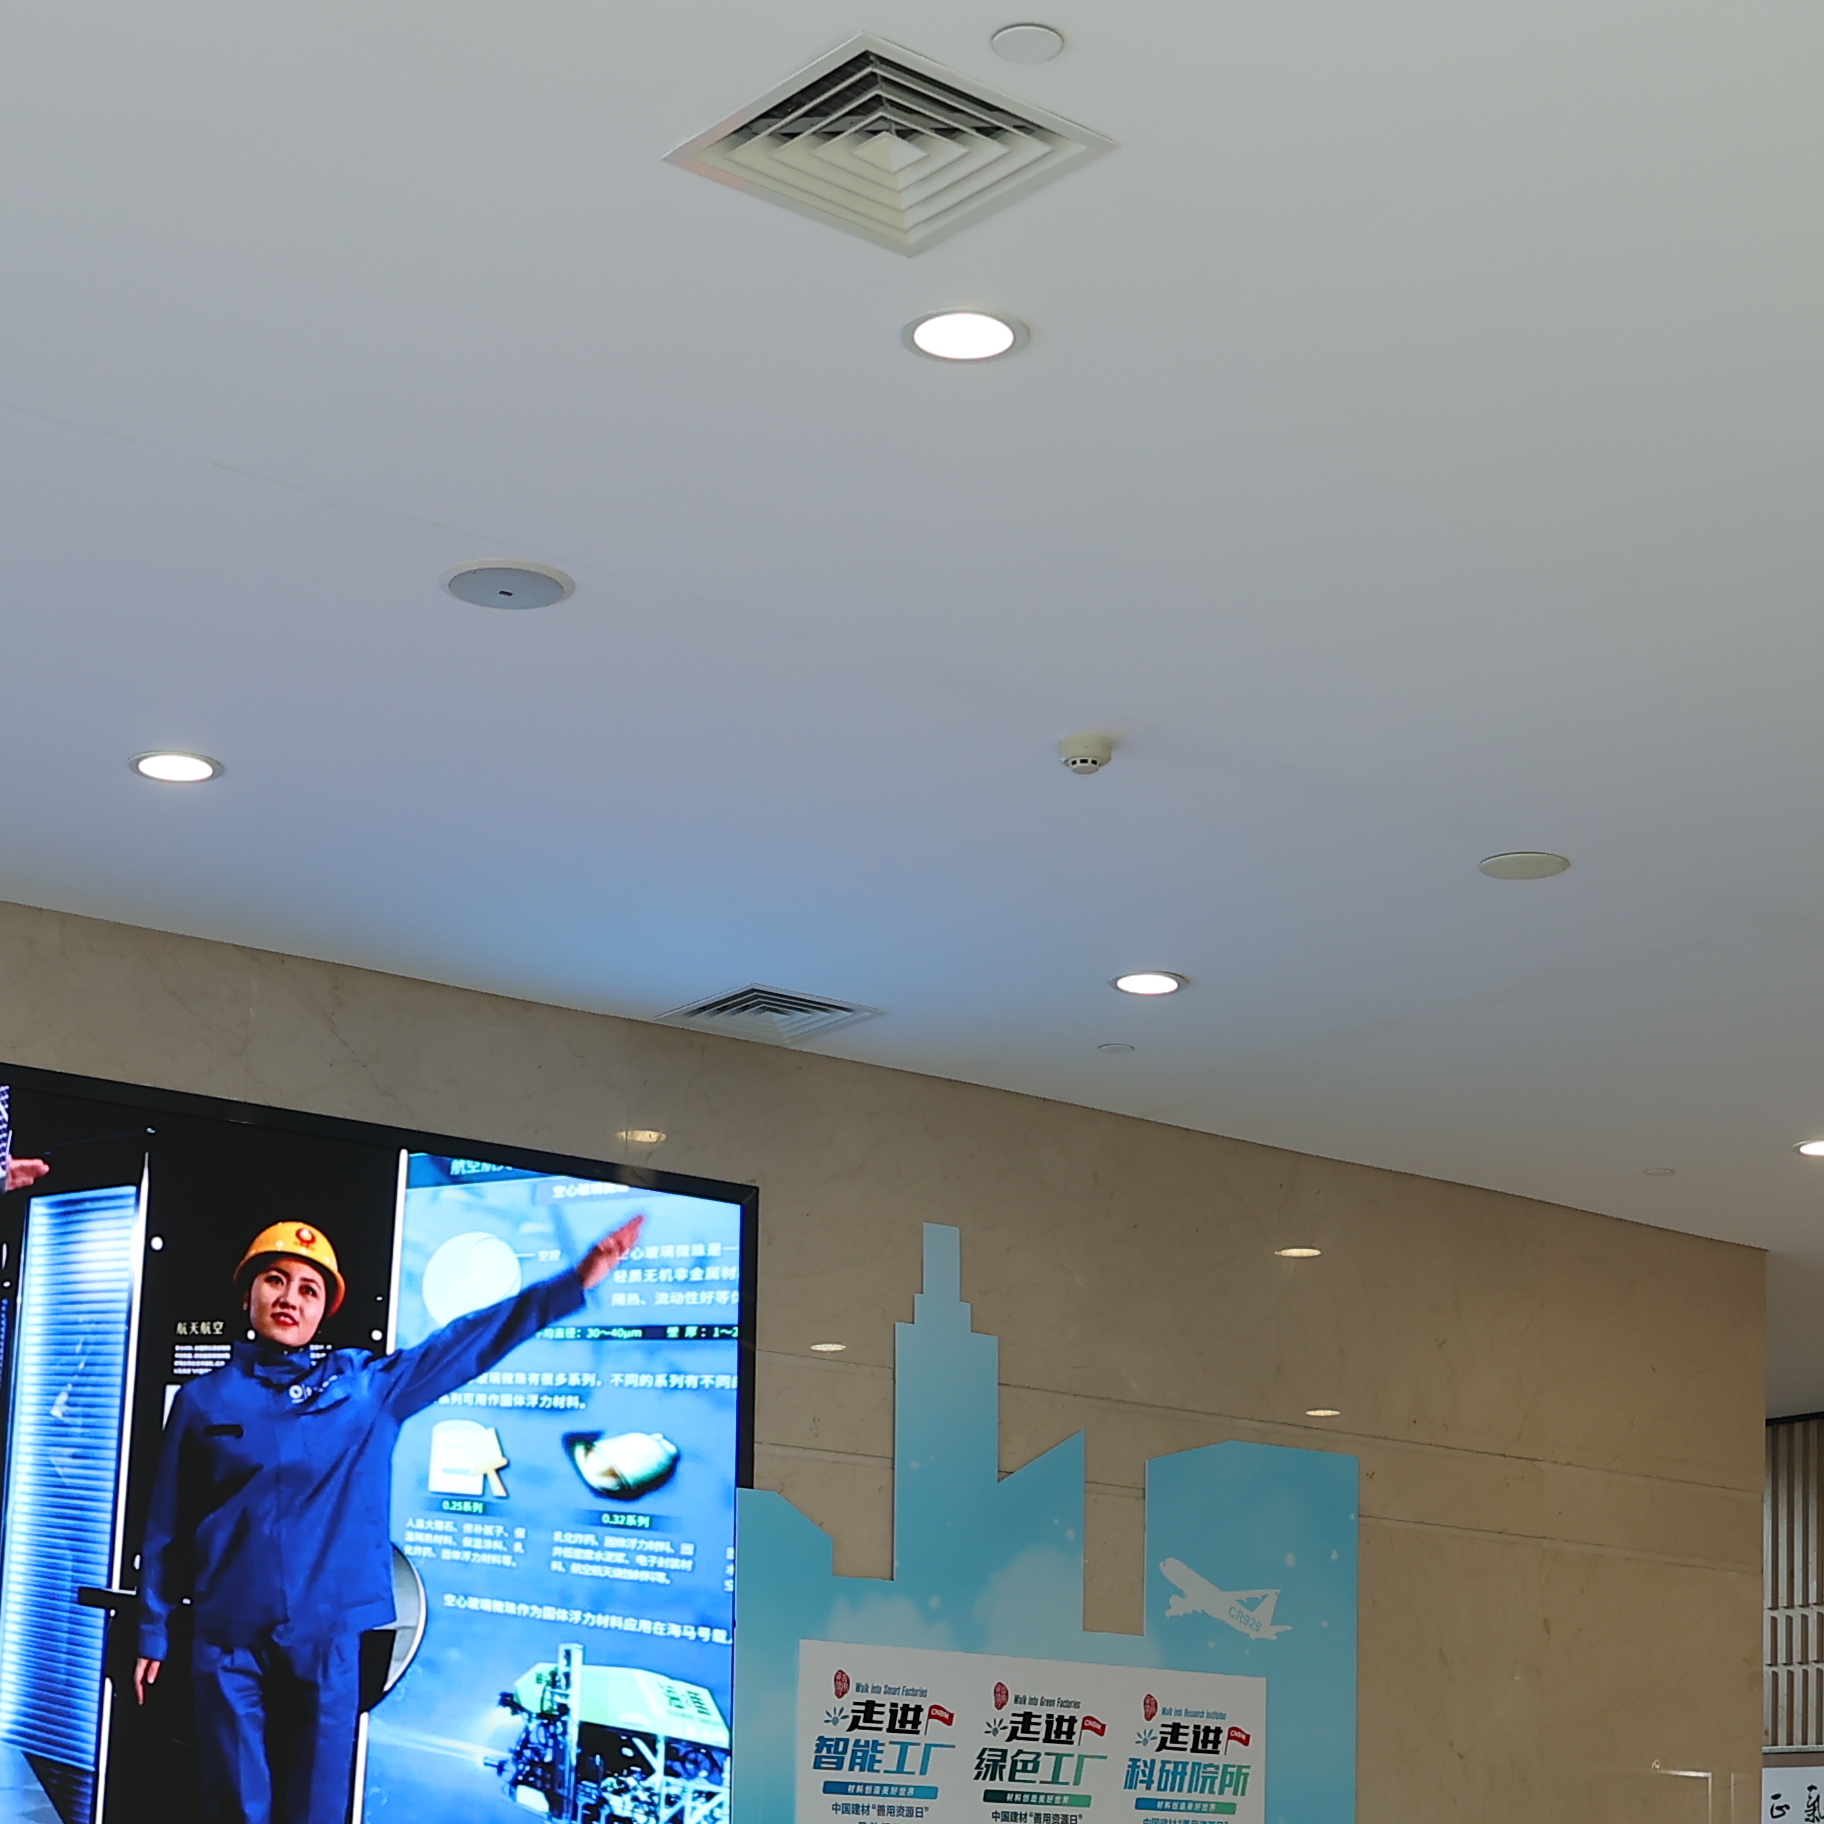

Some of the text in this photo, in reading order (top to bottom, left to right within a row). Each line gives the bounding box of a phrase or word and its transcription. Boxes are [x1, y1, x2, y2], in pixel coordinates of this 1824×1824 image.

[602, 1513, 650, 1528] 0.32系列
[1228, 1606, 1262, 1632] CR929
[855, 1682, 870, 1694] Walk
[883, 1684, 901, 1697] Smart
[1013, 1694, 1026, 1705] Walk
[845, 1699, 924, 1735] 走进
[1005, 1711, 1078, 1745] 走进
[1155, 1722, 1223, 1755] 走进
[812, 1735, 956, 1776] 智能工厂
[973, 1747, 1108, 1786] 绿色工厂
[847, 1784, 915, 1796] 材料创造美好世界
[1124, 1757, 1251, 1797] 科研院所
[1006, 1793, 1070, 1805] 材料创造美好世界
